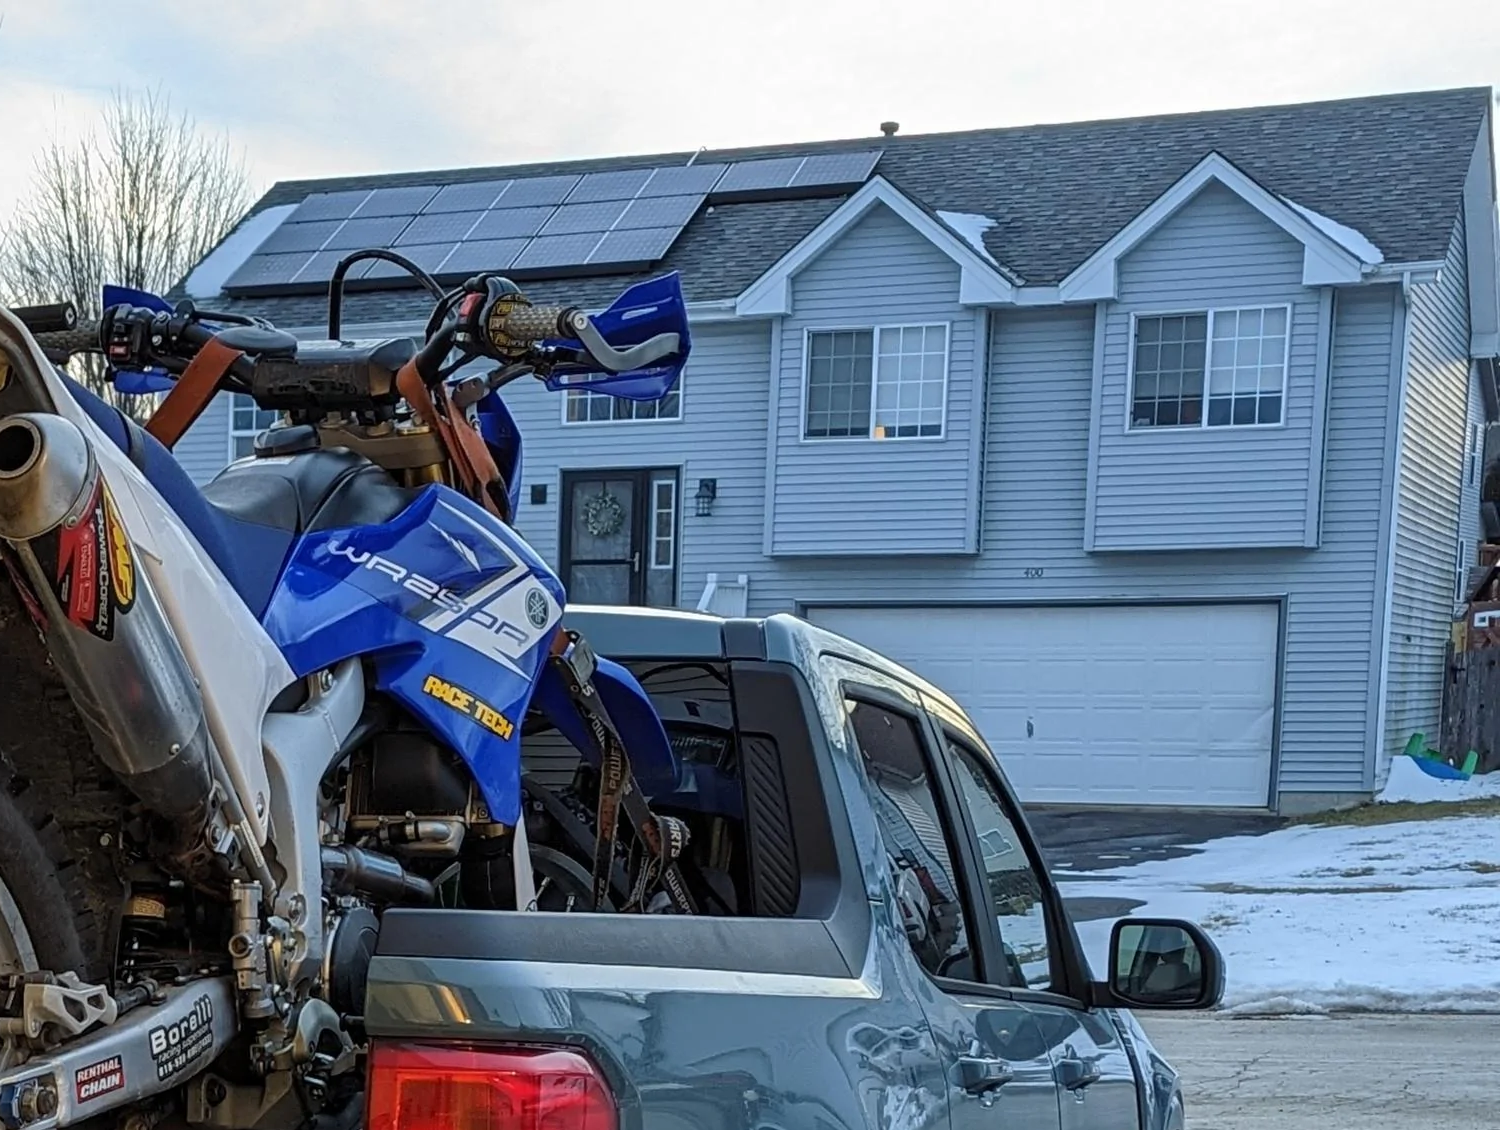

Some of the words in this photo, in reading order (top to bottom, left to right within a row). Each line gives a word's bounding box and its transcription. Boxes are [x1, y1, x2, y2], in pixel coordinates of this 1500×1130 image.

[423, 675, 475, 714] RACE
[474, 700, 514, 741] TECH
[150, 996, 212, 1056] Borelli
[77, 1057, 120, 1082] RENTHAL
[80, 1072, 121, 1098] CHAIN
